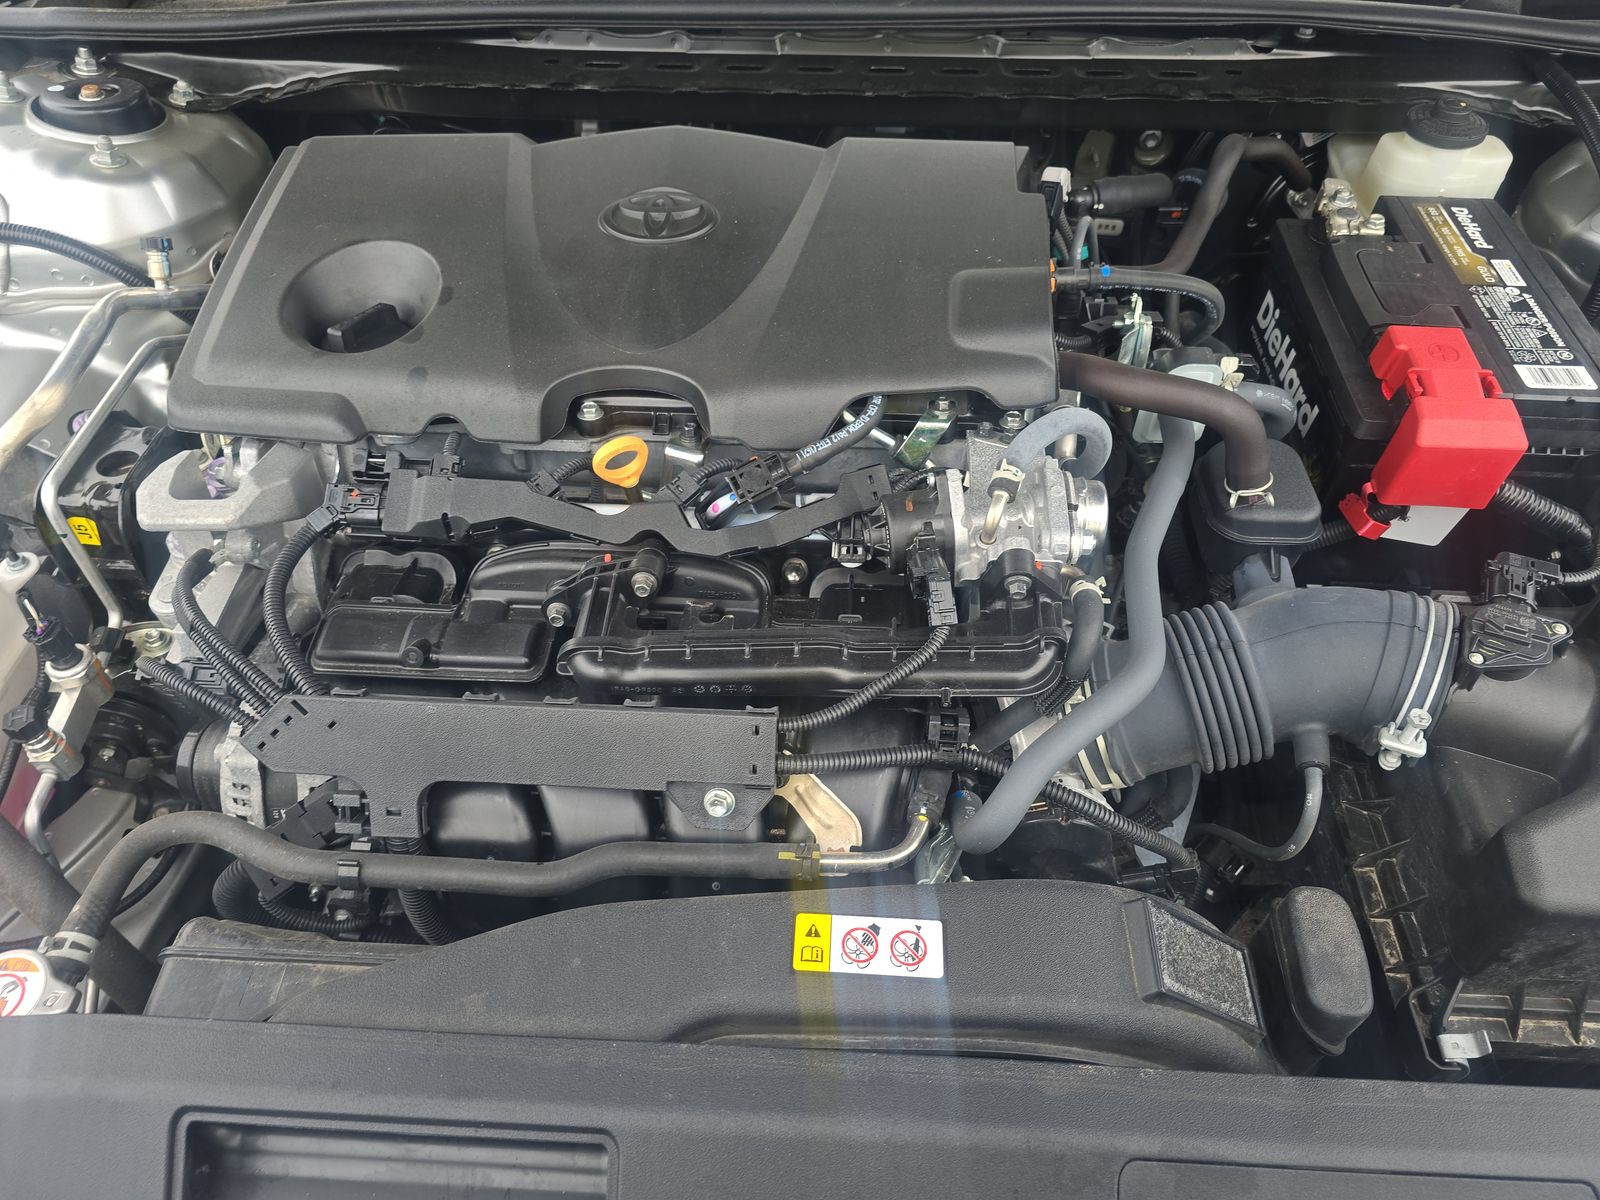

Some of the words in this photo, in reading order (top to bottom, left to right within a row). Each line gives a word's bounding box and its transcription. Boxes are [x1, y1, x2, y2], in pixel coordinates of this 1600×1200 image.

[1450, 206, 1494, 249] DieHard
[1477, 265, 1495, 283] GOLD
[1256, 289, 1320, 438] DieHard
[72, 524, 93, 539] J5
